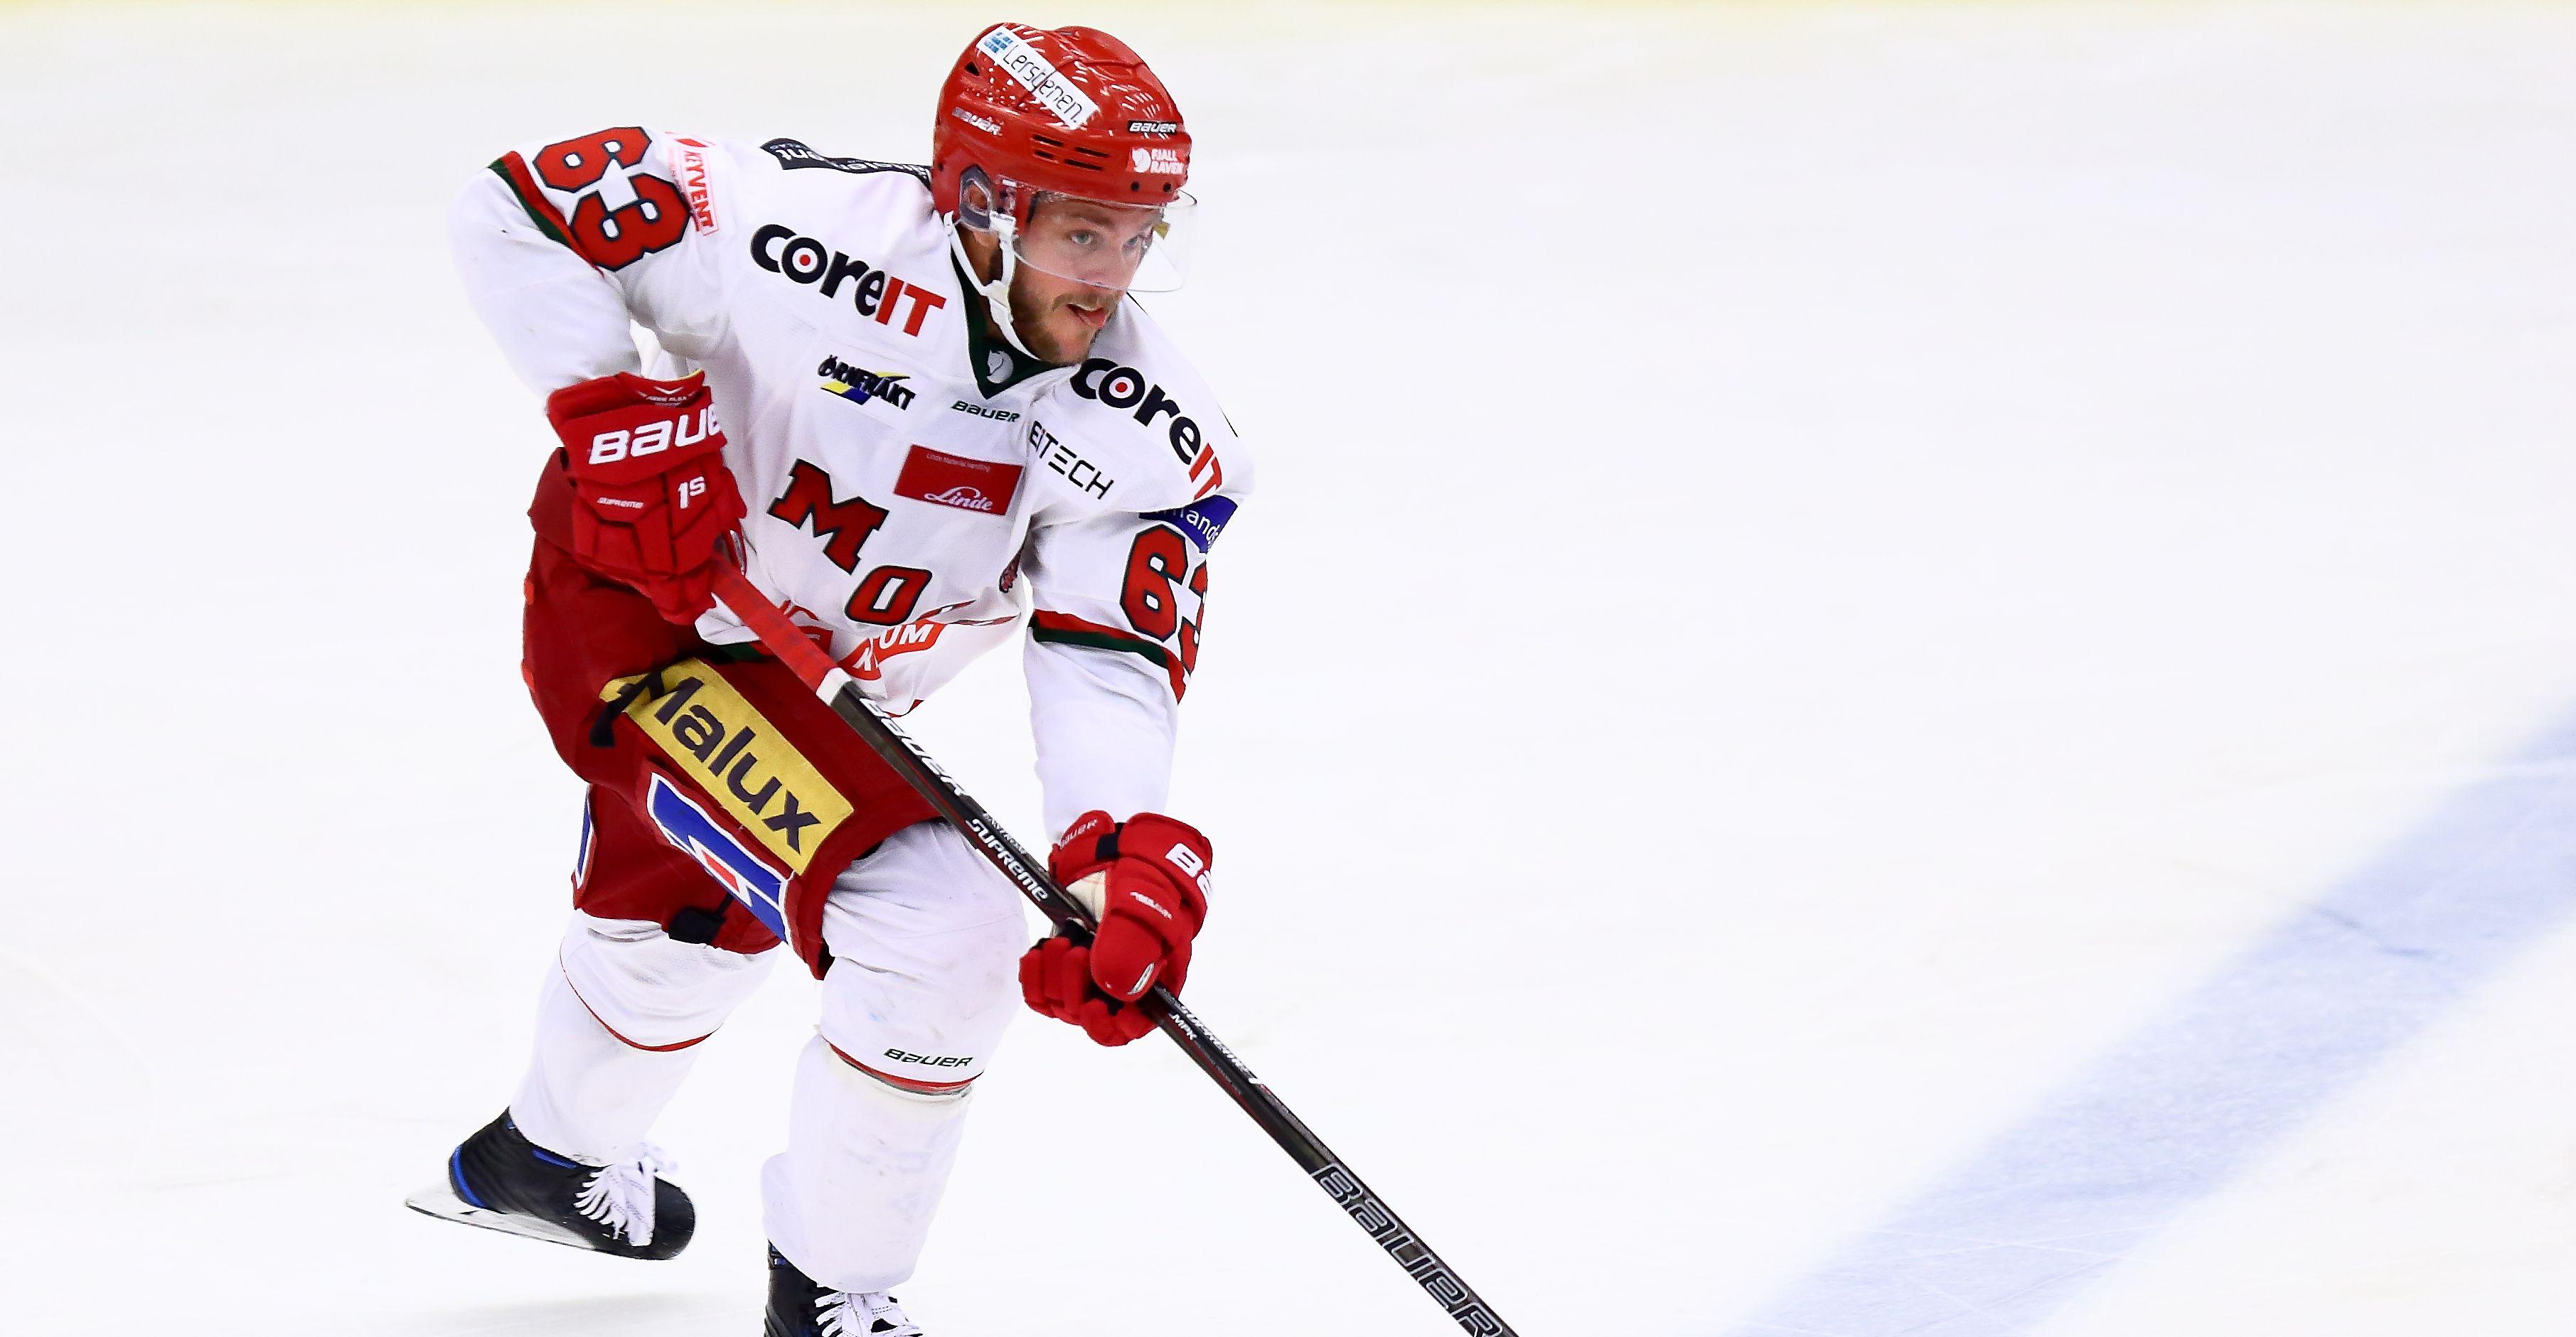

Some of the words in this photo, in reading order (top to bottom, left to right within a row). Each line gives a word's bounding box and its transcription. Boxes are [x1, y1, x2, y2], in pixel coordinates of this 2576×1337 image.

[533, 126, 692, 272] 63
[749, 223, 947, 338] coreIT
[951, 399, 1021, 423] BAUER
[1069, 357, 1223, 502] coreIT
[924, 485, 994, 510] Linde
[965, 817, 1049, 903] SUPREME
[884, 1048, 973, 1068] BAUER
[1310, 1161, 1505, 1337] BAUER
